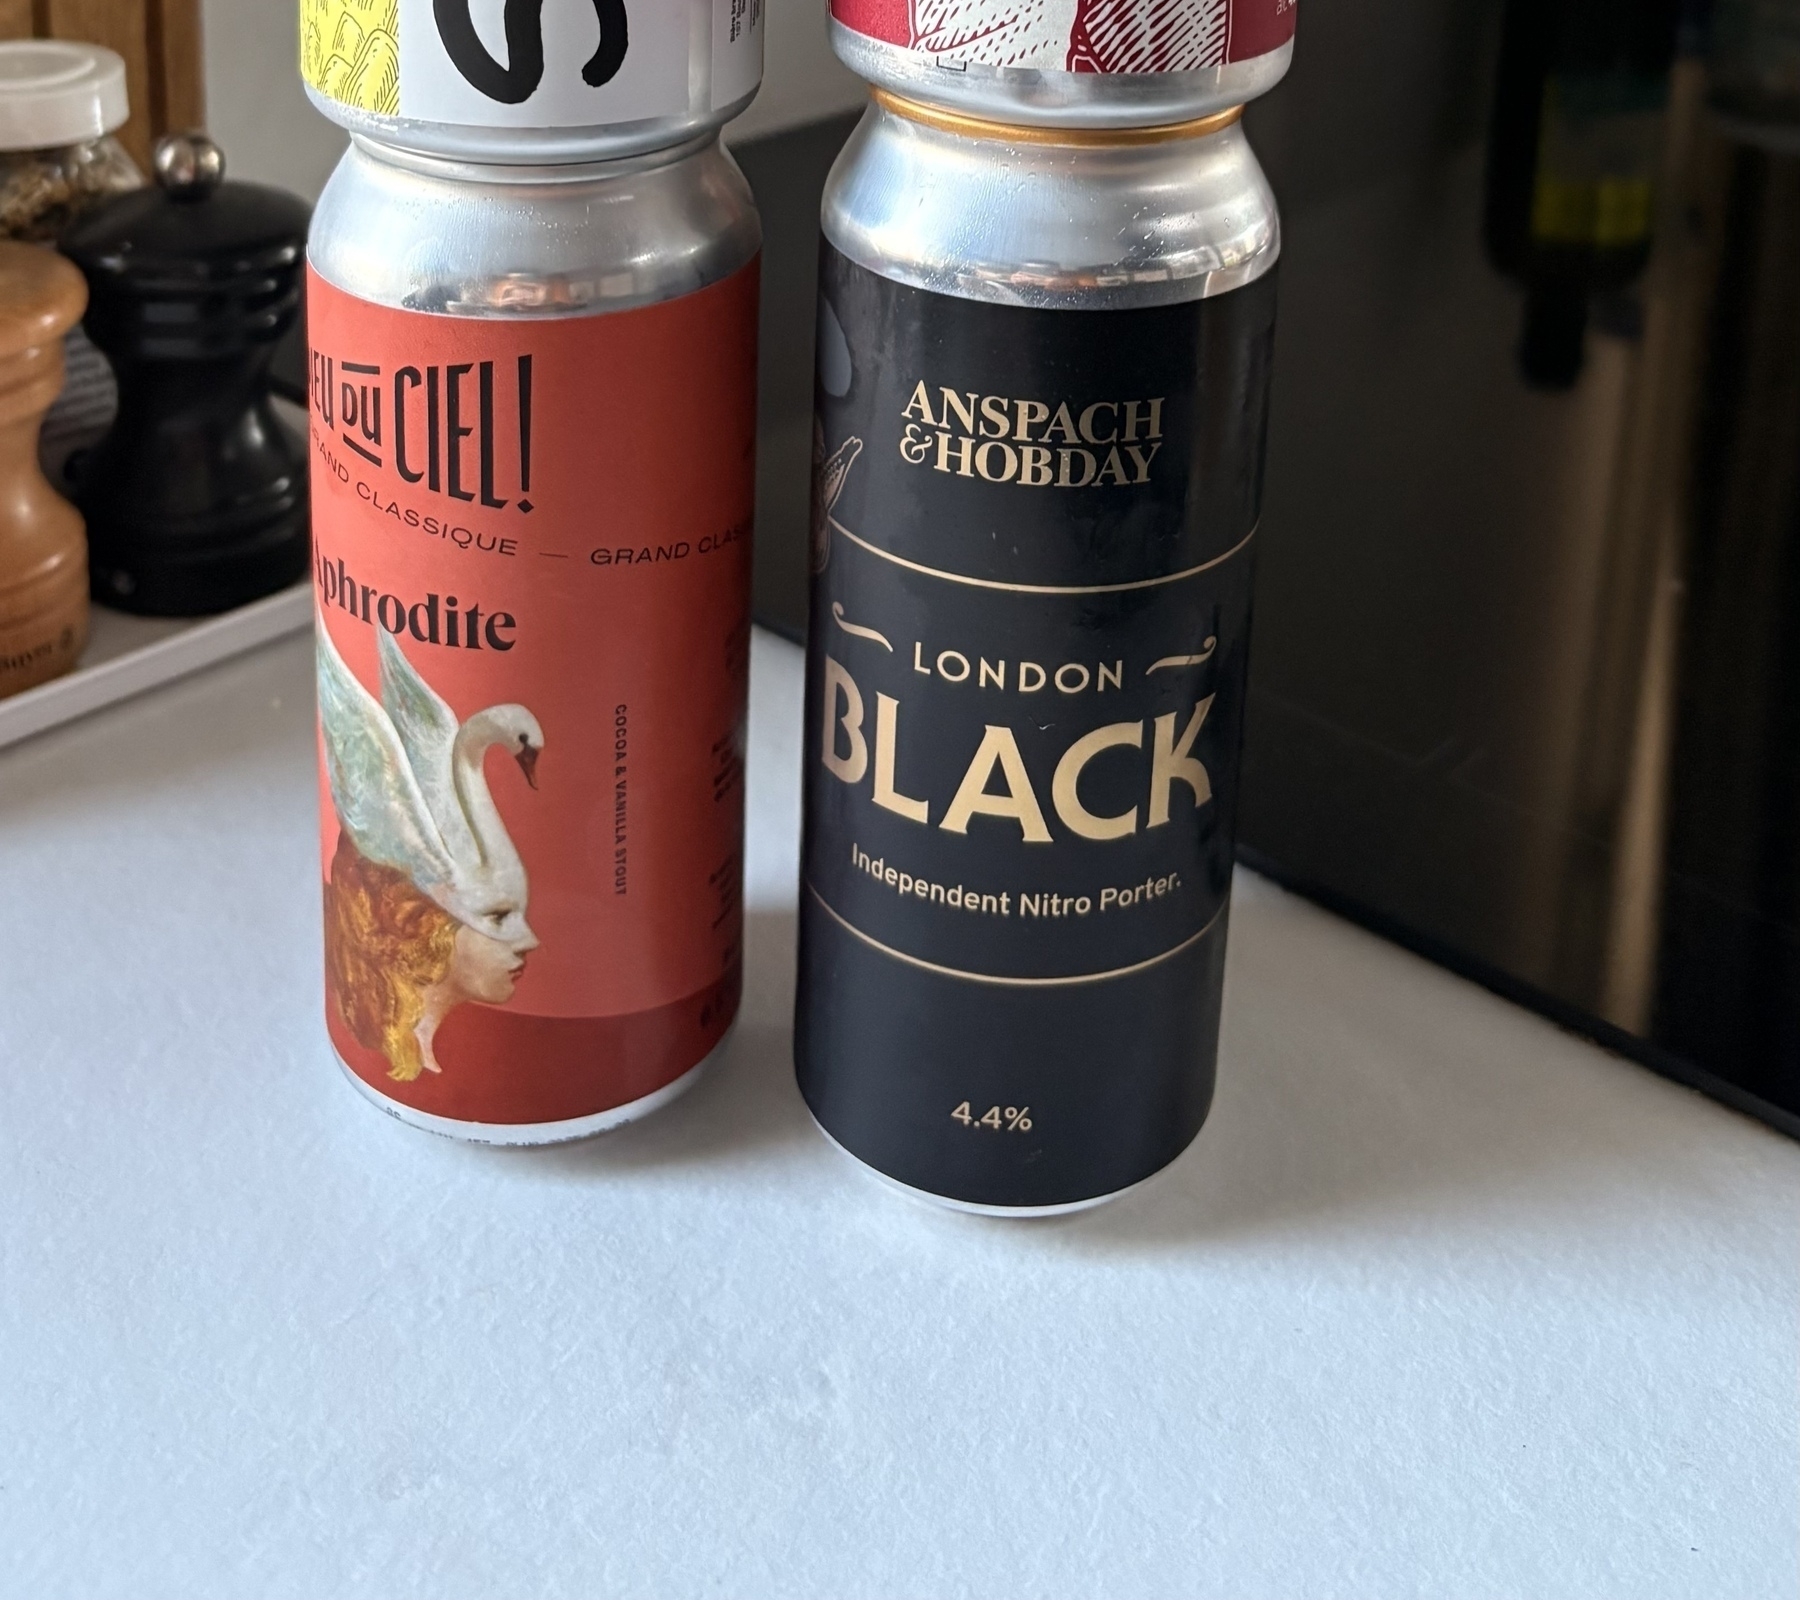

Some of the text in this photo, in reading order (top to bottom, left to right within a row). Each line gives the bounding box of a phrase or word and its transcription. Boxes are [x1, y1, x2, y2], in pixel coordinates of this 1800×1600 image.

[309, 346, 535, 515] IEU DU CIEL!
[899, 423, 1163, 489] &HOBDAY
[901, 379, 1166, 446] ANSPACH
[311, 418, 350, 485] RAND
[356, 480, 519, 558] CLASSIQUE
[590, 541, 690, 566] GRAND
[314, 533, 518, 652] Aphrodite
[914, 641, 1123, 694] LONDON
[821, 653, 1217, 844] BLACK
[615, 704, 627, 895] COCOA & VANILLA STOUT
[852, 842, 1183, 918] Independent Nitro Porter.
[951, 1100, 1034, 1133] 4.4%
